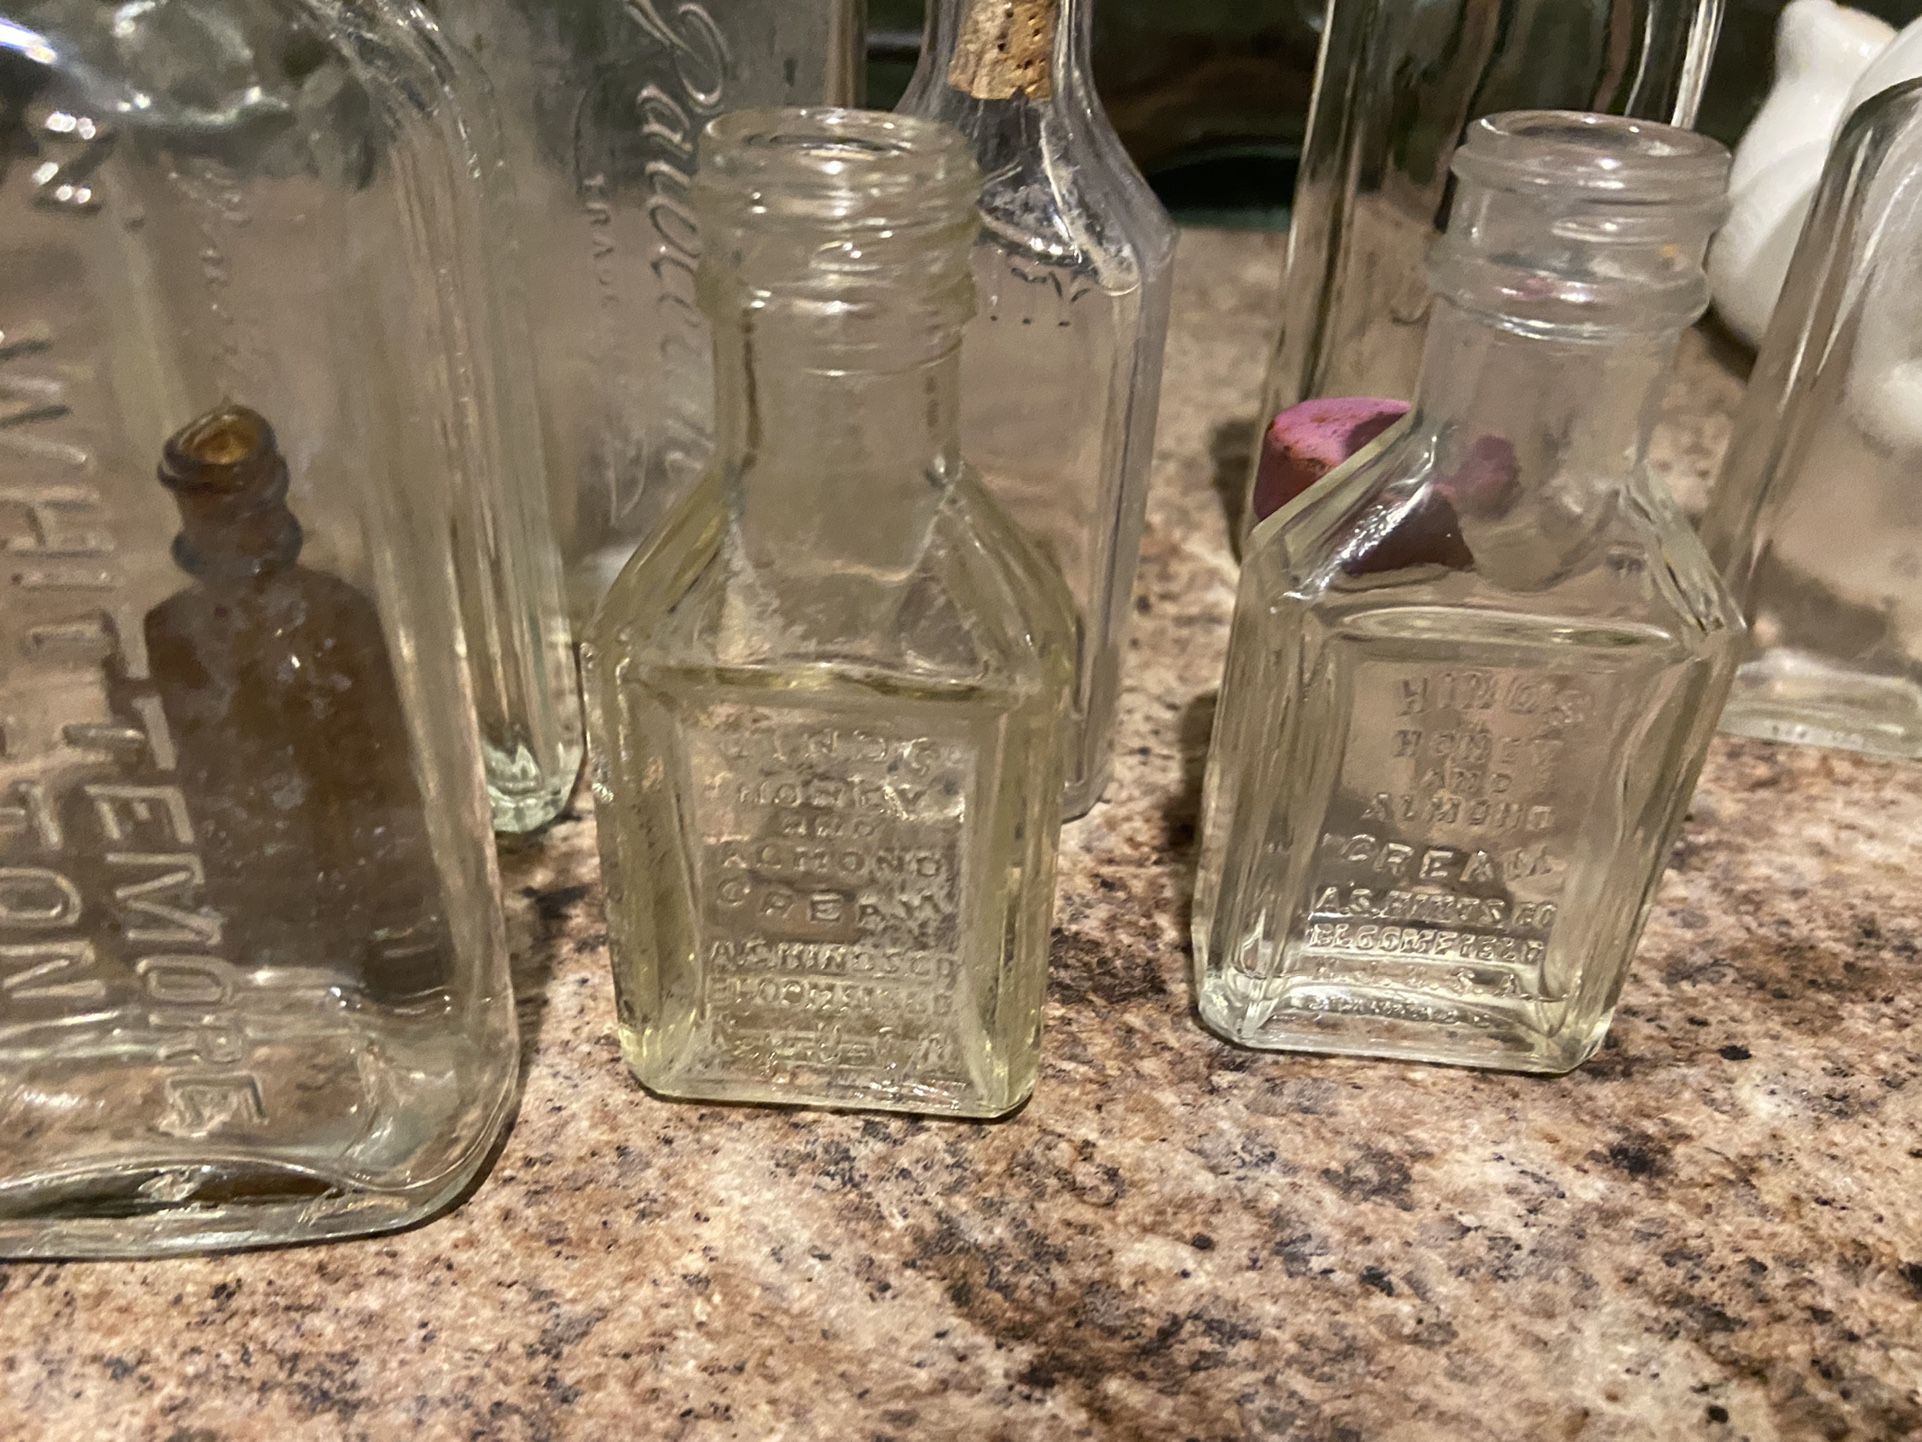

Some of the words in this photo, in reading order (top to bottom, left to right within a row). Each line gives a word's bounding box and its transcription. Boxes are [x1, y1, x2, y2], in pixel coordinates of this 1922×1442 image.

[1362, 792, 1555, 829] ALMOND
[721, 843, 943, 878] ALMOND
[1341, 833, 1555, 882] CREAM
[717, 876, 945, 930] CREAM
